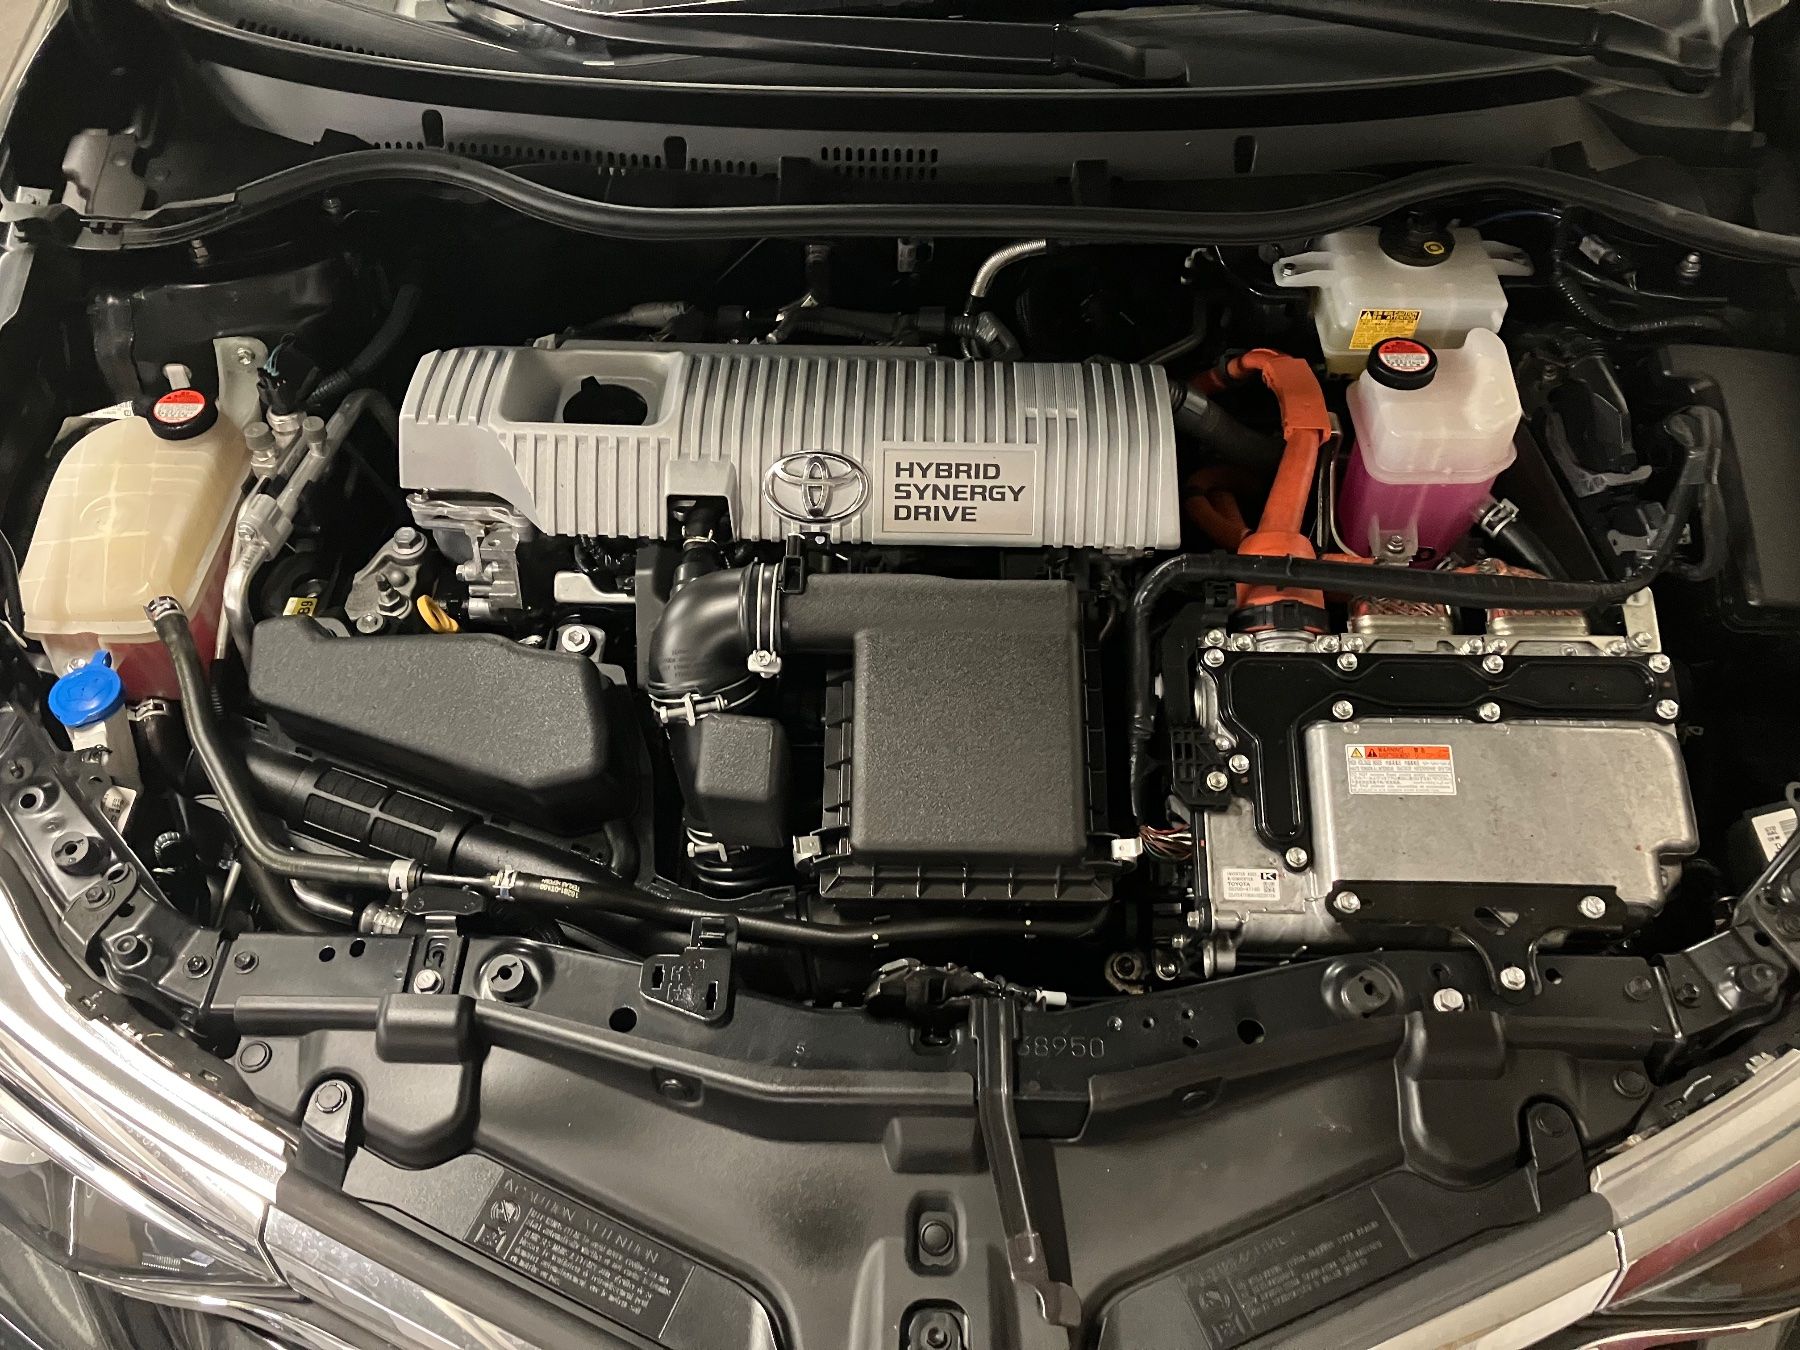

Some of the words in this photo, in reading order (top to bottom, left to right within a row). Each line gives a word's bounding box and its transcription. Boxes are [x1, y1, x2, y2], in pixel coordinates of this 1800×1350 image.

[895, 461, 1001, 480] HYBRID
[894, 483, 1026, 502] SYNERGY
[894, 504, 978, 522] DRIVE
